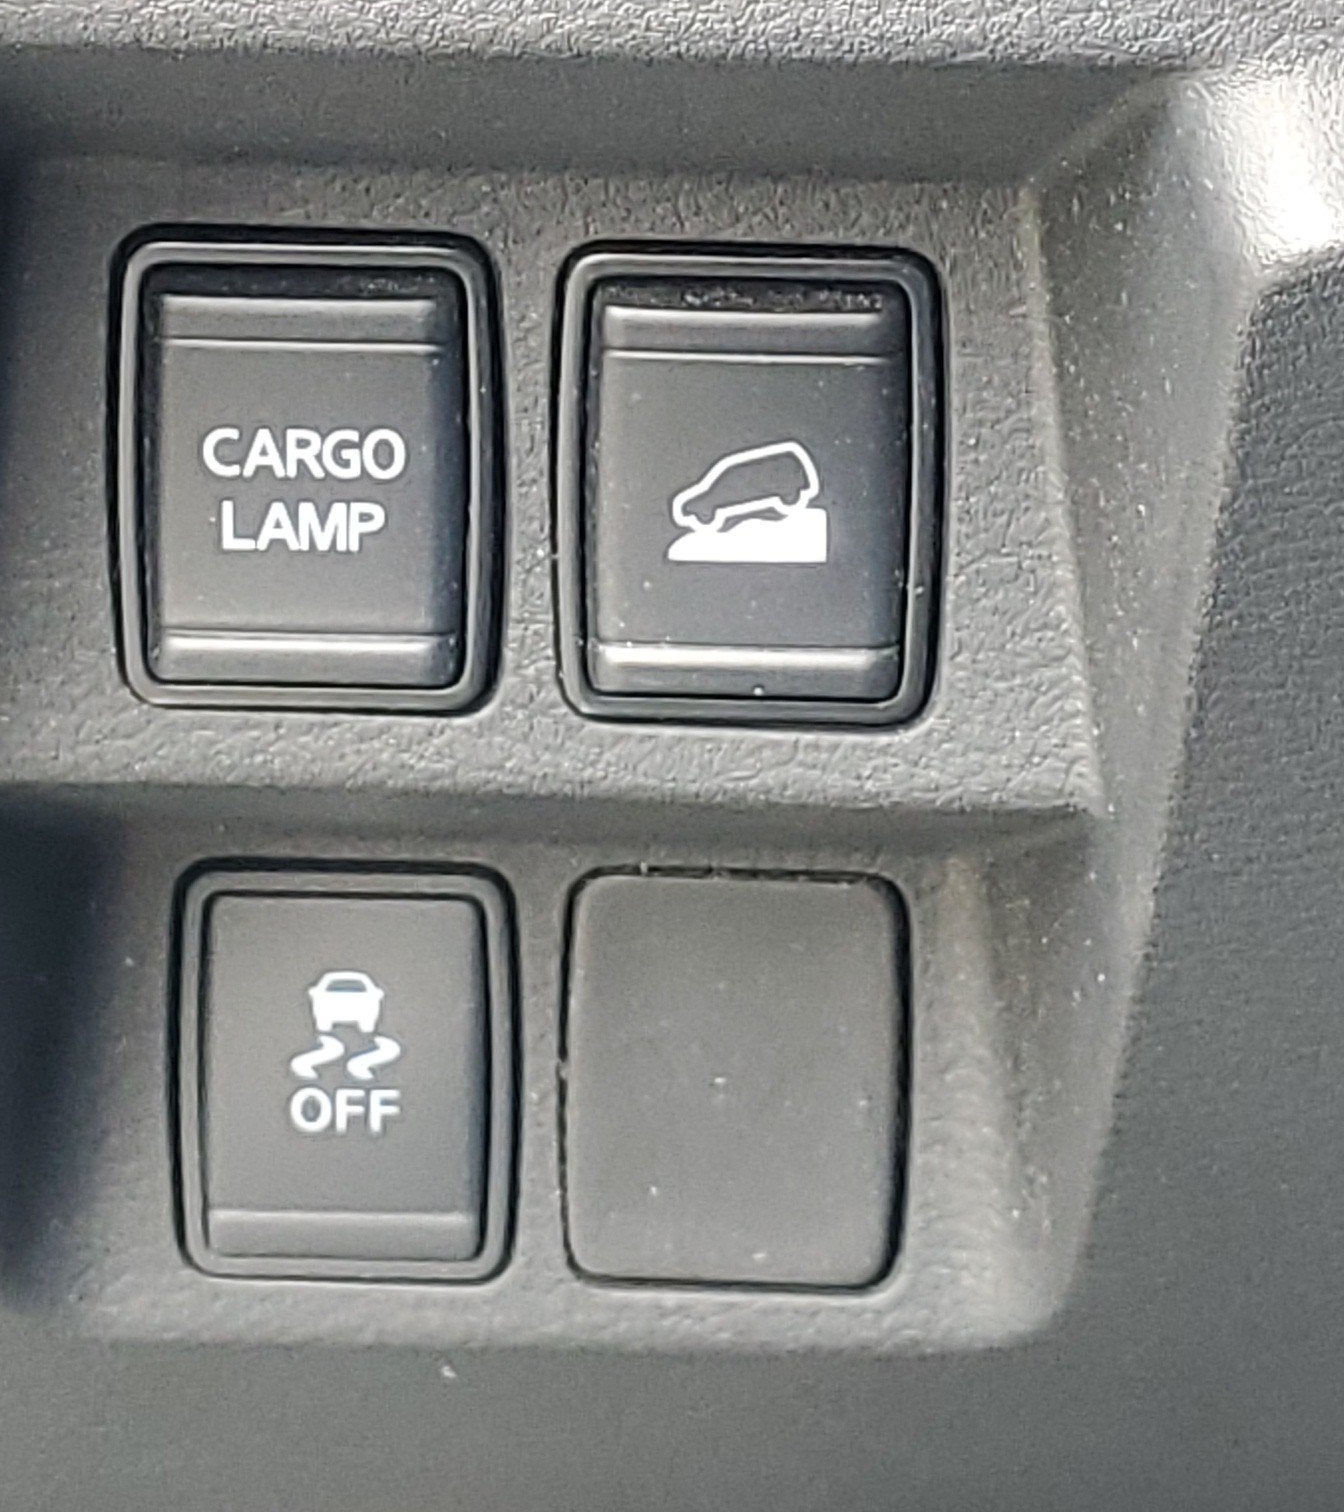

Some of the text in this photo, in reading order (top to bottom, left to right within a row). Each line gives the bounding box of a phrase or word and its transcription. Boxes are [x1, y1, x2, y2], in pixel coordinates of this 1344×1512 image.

[201, 426, 407, 481] CARGO
[220, 499, 386, 553] LAMP
[289, 1086, 402, 1134] OFF
